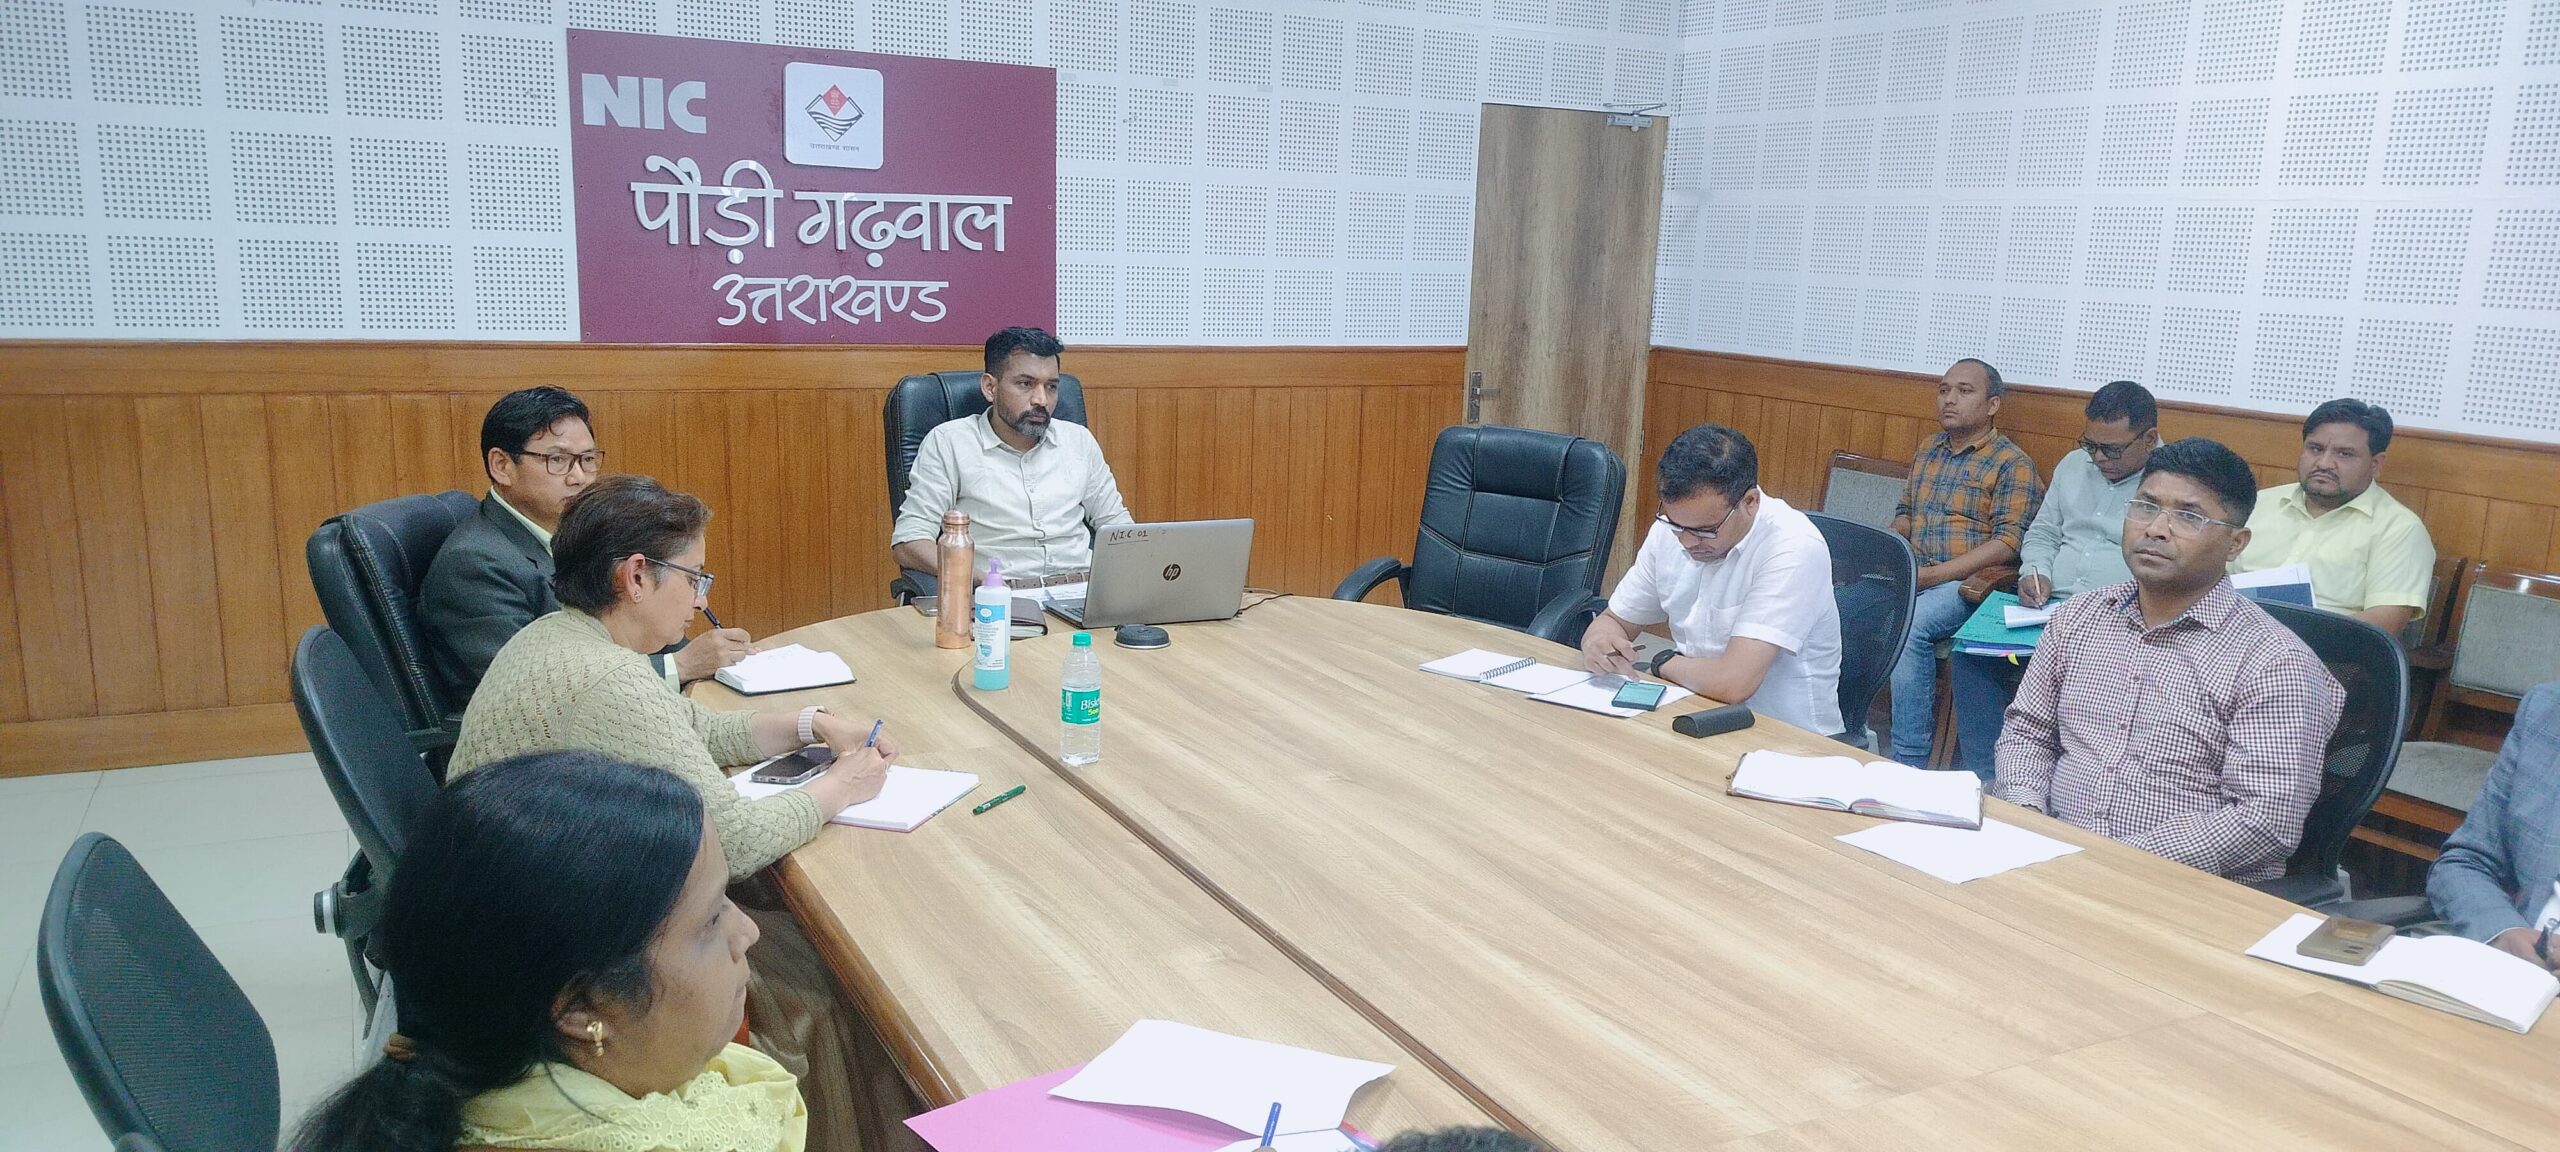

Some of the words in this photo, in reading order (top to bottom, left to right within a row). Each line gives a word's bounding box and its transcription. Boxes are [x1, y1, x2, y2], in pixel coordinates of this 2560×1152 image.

[582, 73, 707, 134] NIC
[630, 156, 783, 264] पौड़ी
[793, 190, 1013, 267] गढ़वाल
[713, 273, 949, 326] उत्तराखण्ड
[1163, 564, 1181, 581] hp
